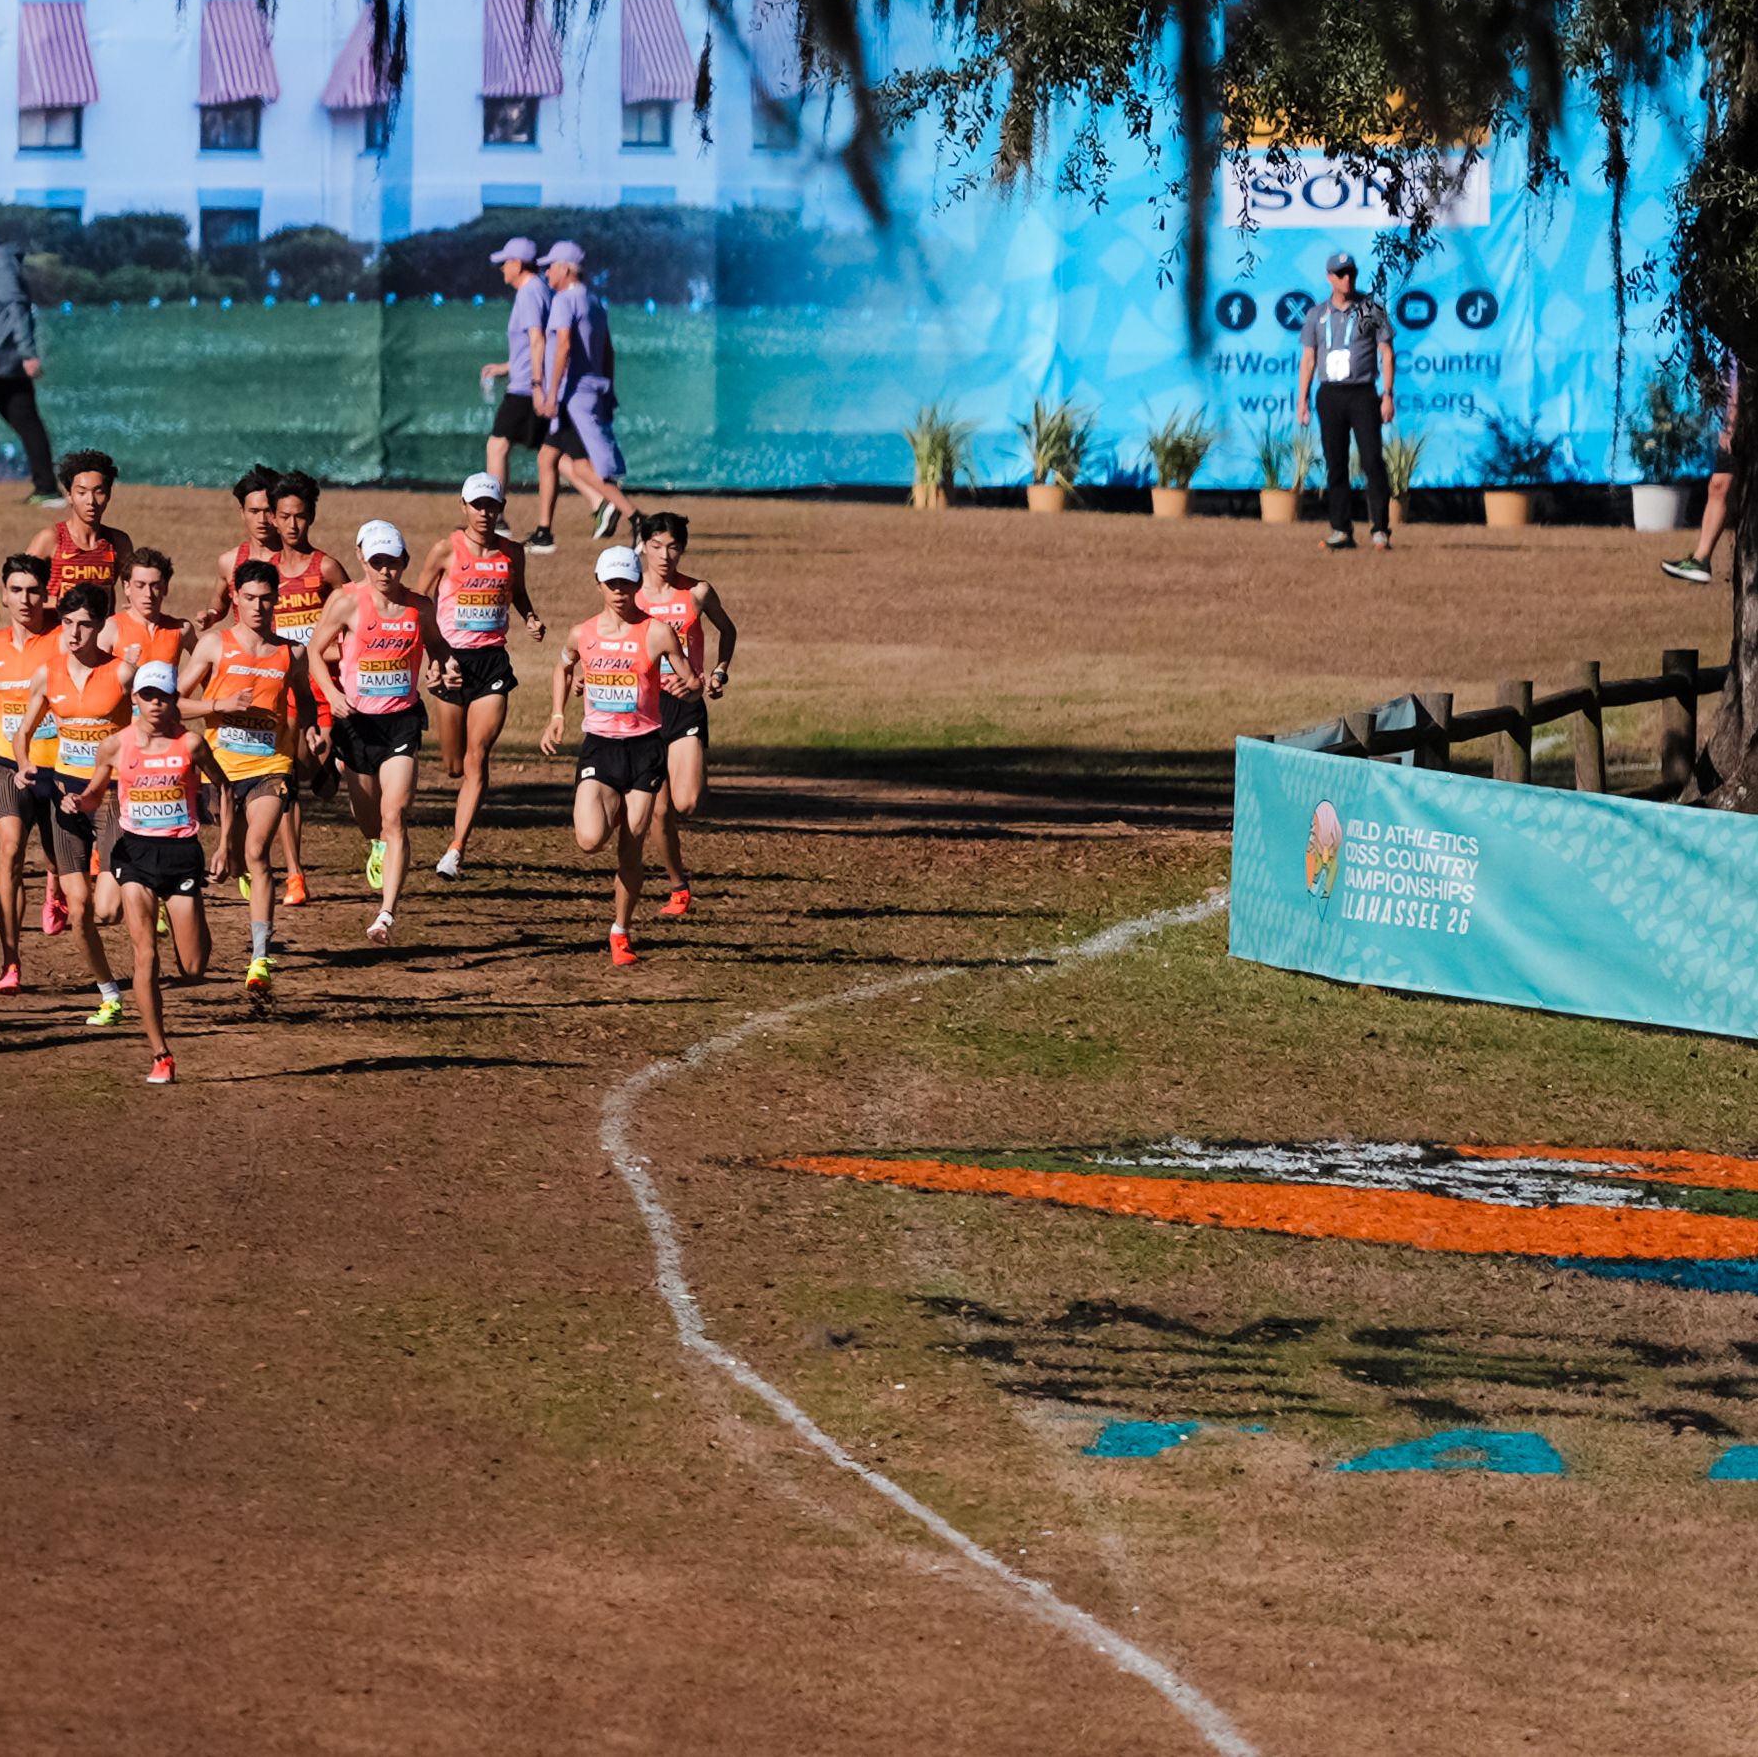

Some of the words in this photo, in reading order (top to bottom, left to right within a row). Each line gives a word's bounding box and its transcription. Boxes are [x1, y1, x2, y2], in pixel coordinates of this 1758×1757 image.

[61, 565, 112, 580] CHINA
[461, 577, 508, 589] JAPAN
[457, 593, 506, 605] SEIKO
[277, 612, 323, 628] SEIKO
[367, 638, 413, 650] JAPAN
[358, 659, 409, 672] SEIKO
[587, 657, 633, 670] JAPAN
[360, 672, 410, 687] TAMURA
[586, 673, 636, 686] SEIKO
[3, 703, 28, 715] SEI
[221, 714, 277, 730] SEIKO
[59, 727, 109, 741] SEIKO
[62, 741, 98, 756] IBAÑE
[131, 774, 181, 788] JAPAN
[129, 788, 184, 802] SEIKO
[131, 803, 184, 818] HONDA
[1384, 825, 1479, 856] ATHLETICS
[1384, 847, 1479, 880] COUNTRY
[1344, 866, 1476, 904] CAMPIONSHIPS
[1445, 907, 1472, 935] 26
